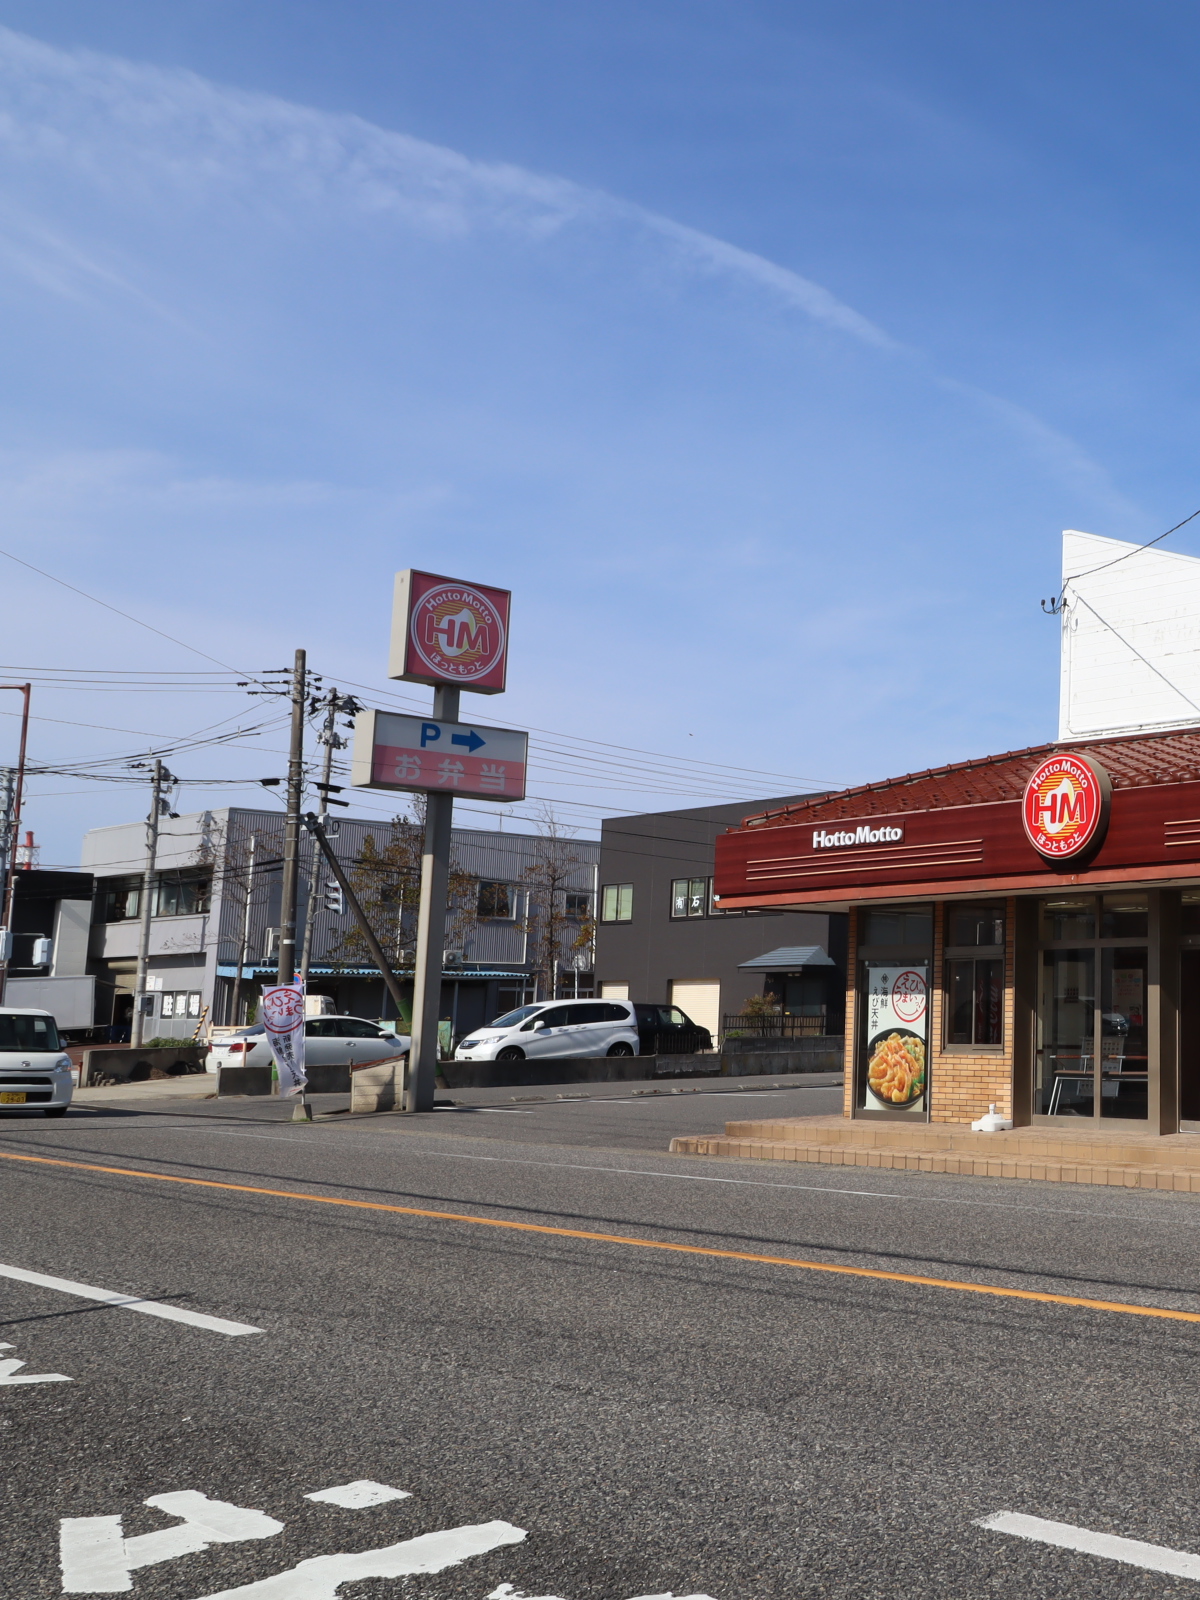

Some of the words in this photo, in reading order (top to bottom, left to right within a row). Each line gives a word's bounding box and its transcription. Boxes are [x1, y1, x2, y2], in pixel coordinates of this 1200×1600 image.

[425, 613, 490, 655] HM
[430, 652, 484, 674] ほっともっと
[420, 722, 441, 748] P
[394, 754, 506, 791] お弁当
[1032, 790, 1086, 826] HM
[1037, 832, 1082, 851] ほっともっと
[162, 995, 200, 1015] 駐車場
